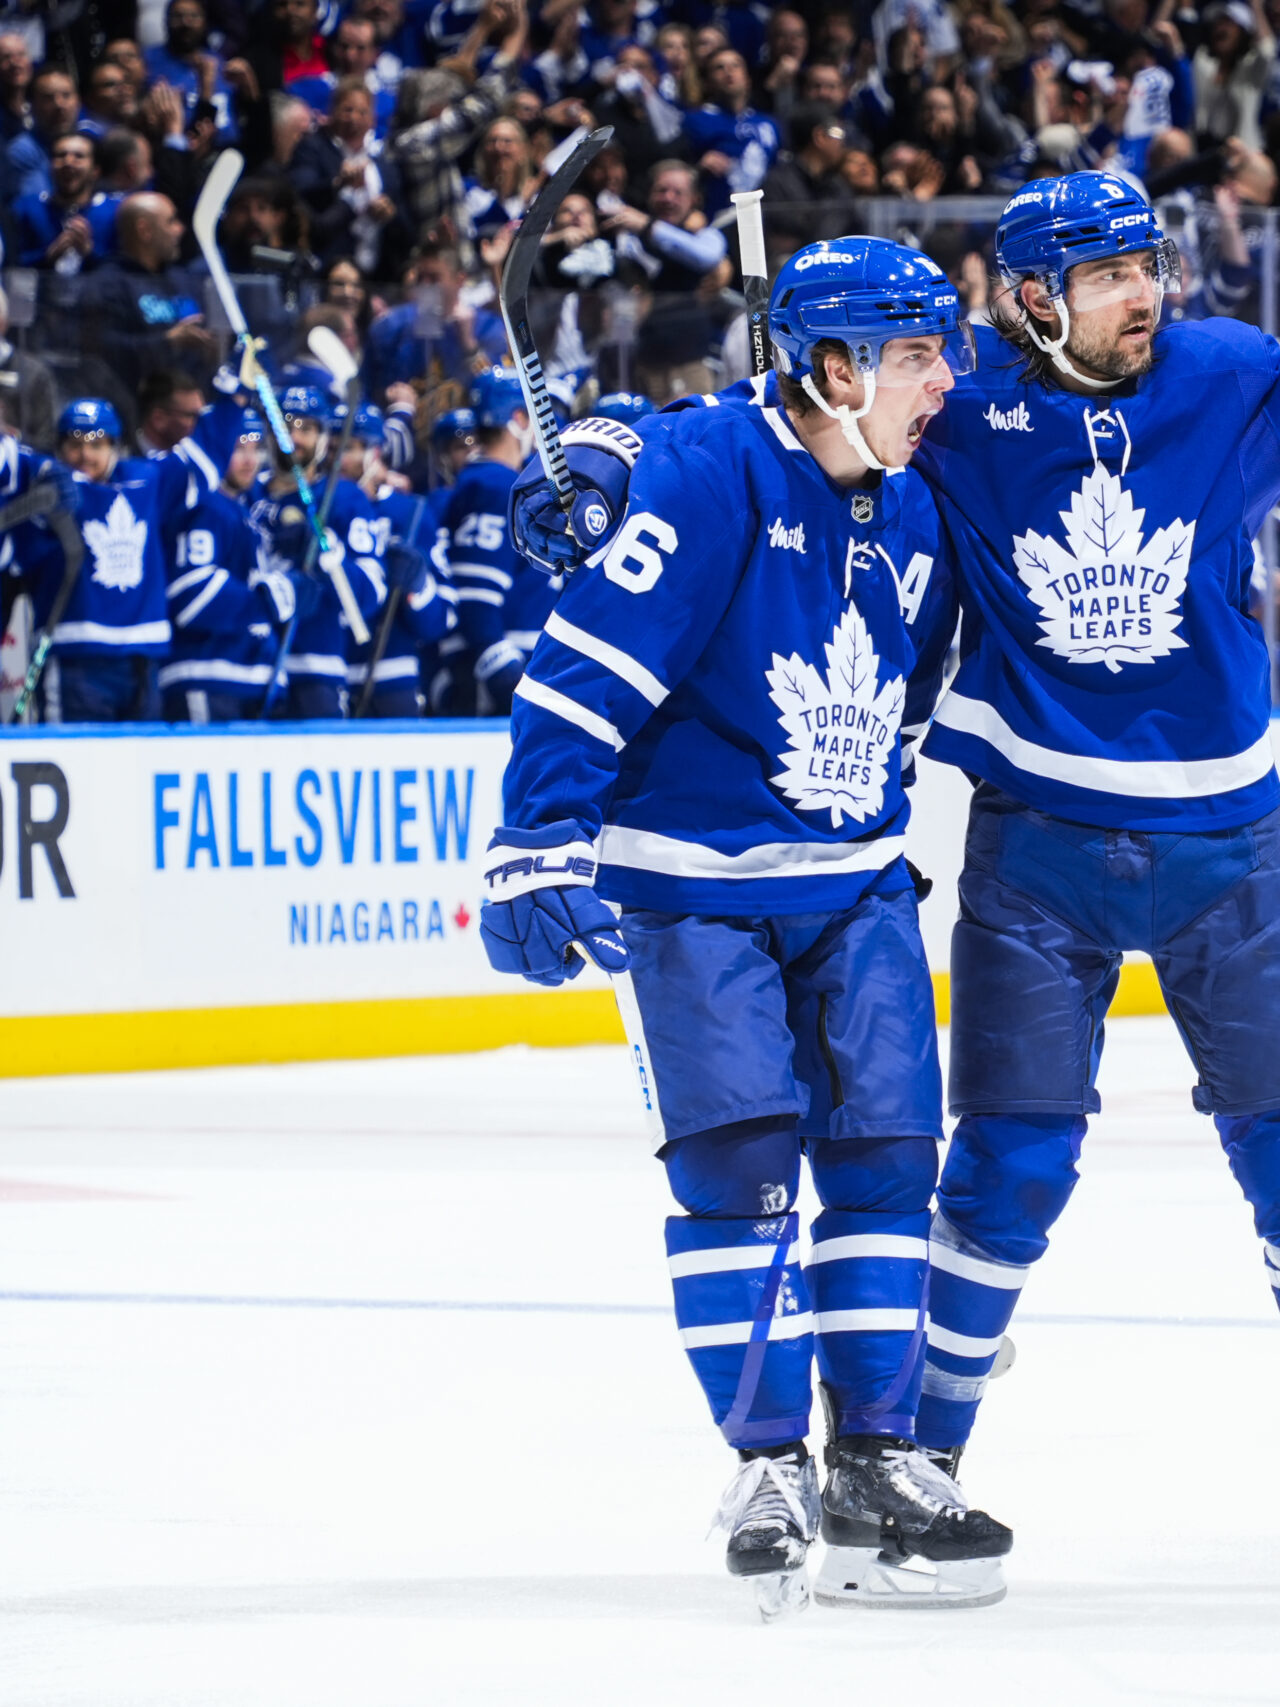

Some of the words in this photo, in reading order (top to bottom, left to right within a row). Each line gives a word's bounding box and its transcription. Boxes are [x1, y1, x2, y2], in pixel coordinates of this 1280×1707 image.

[1003, 192, 1043, 215] OREO
[1110, 213, 1149, 229] CCM
[794, 252, 854, 271] OREO
[934, 295, 957, 307] CCM
[521, 351, 574, 496] WARRIO
[176, 529, 215, 567] 19
[587, 510, 679, 594] 6
[899, 551, 935, 625] A
[1046, 564, 1170, 602] TORONTO
[1069, 594, 1151, 618] MAPLE
[1070, 618, 1152, 640] LEAFS
[798, 704, 888, 746] TORONTO
[813, 732, 876, 762] MAPLE
[808, 757, 871, 786] LEAFS
[153, 767, 475, 870] FALLSVIEW
[484, 856, 597, 888] TRUE
[289, 900, 444, 945] NIAGARA
[634, 1044, 652, 1111] CCM
